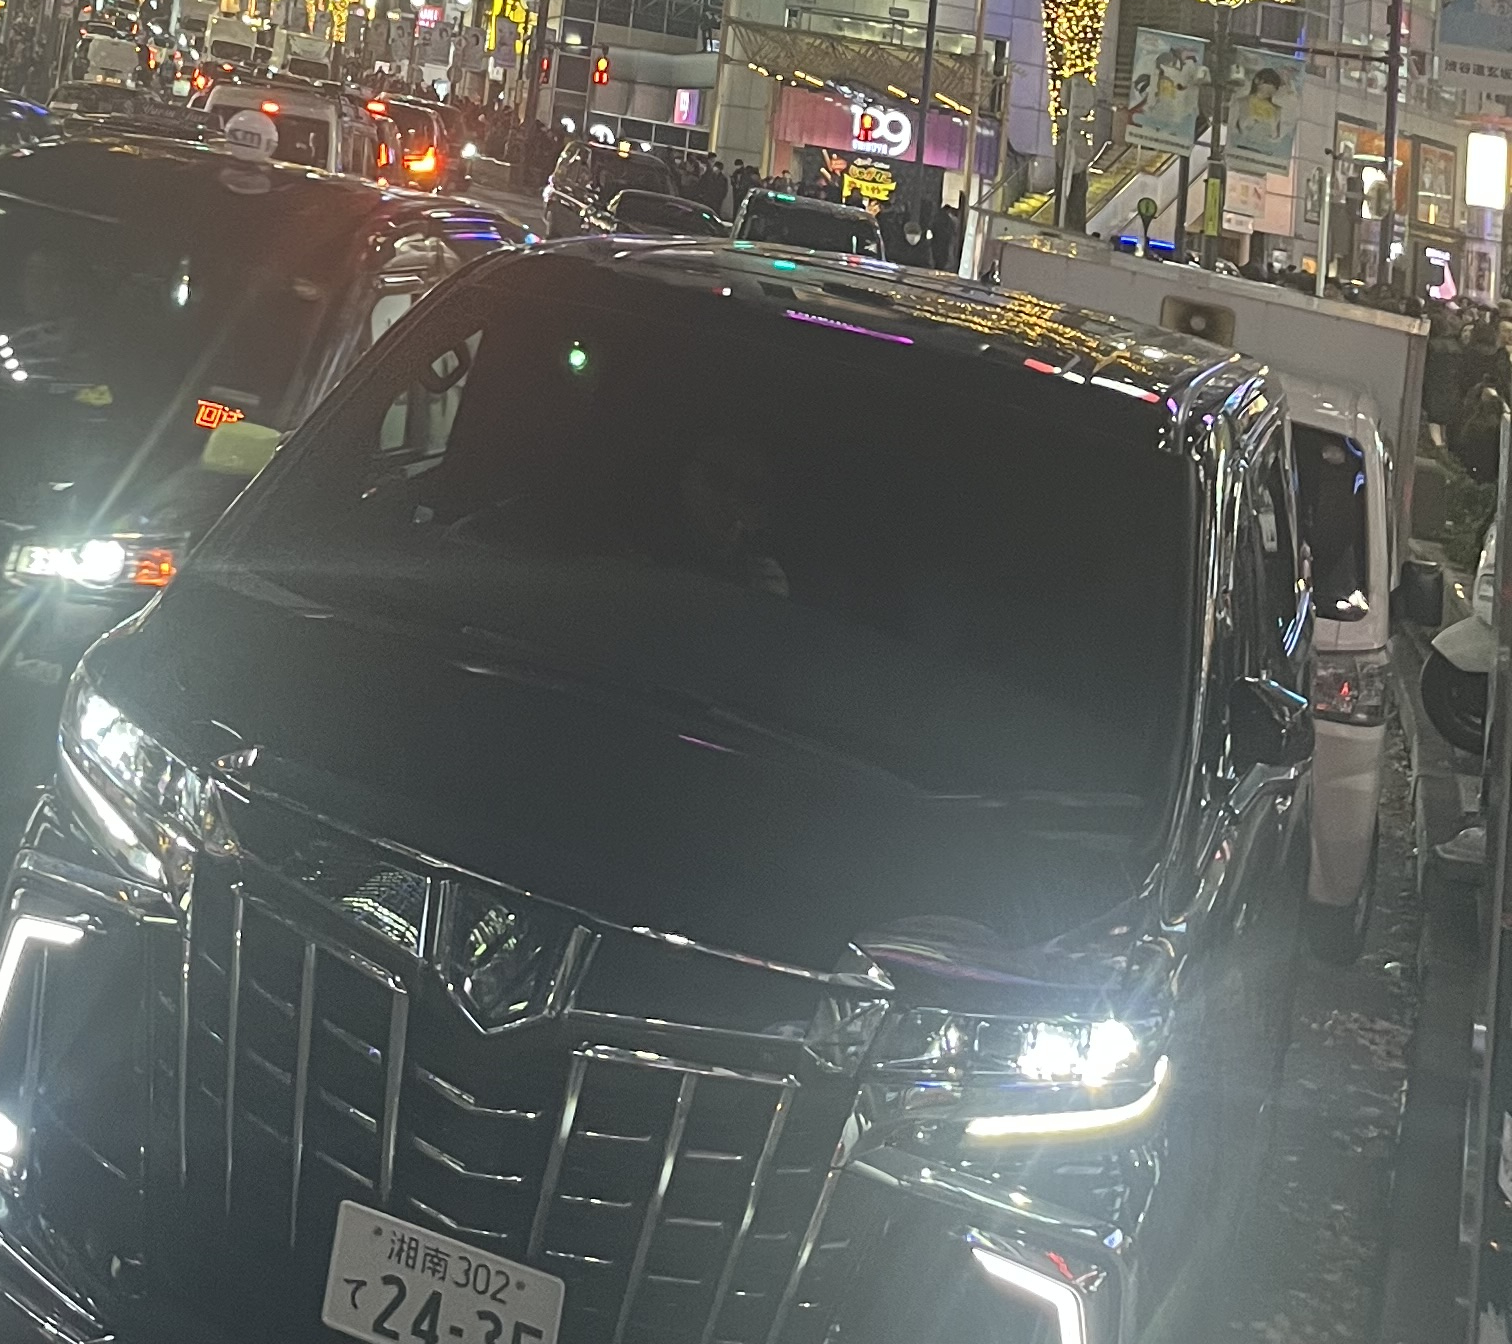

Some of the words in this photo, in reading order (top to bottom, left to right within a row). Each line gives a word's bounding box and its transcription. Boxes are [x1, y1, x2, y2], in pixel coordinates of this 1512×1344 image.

[343, 1277, 368, 1310] て
[388, 1229, 450, 1282] 湘南
[453, 1255, 511, 1305] 302
